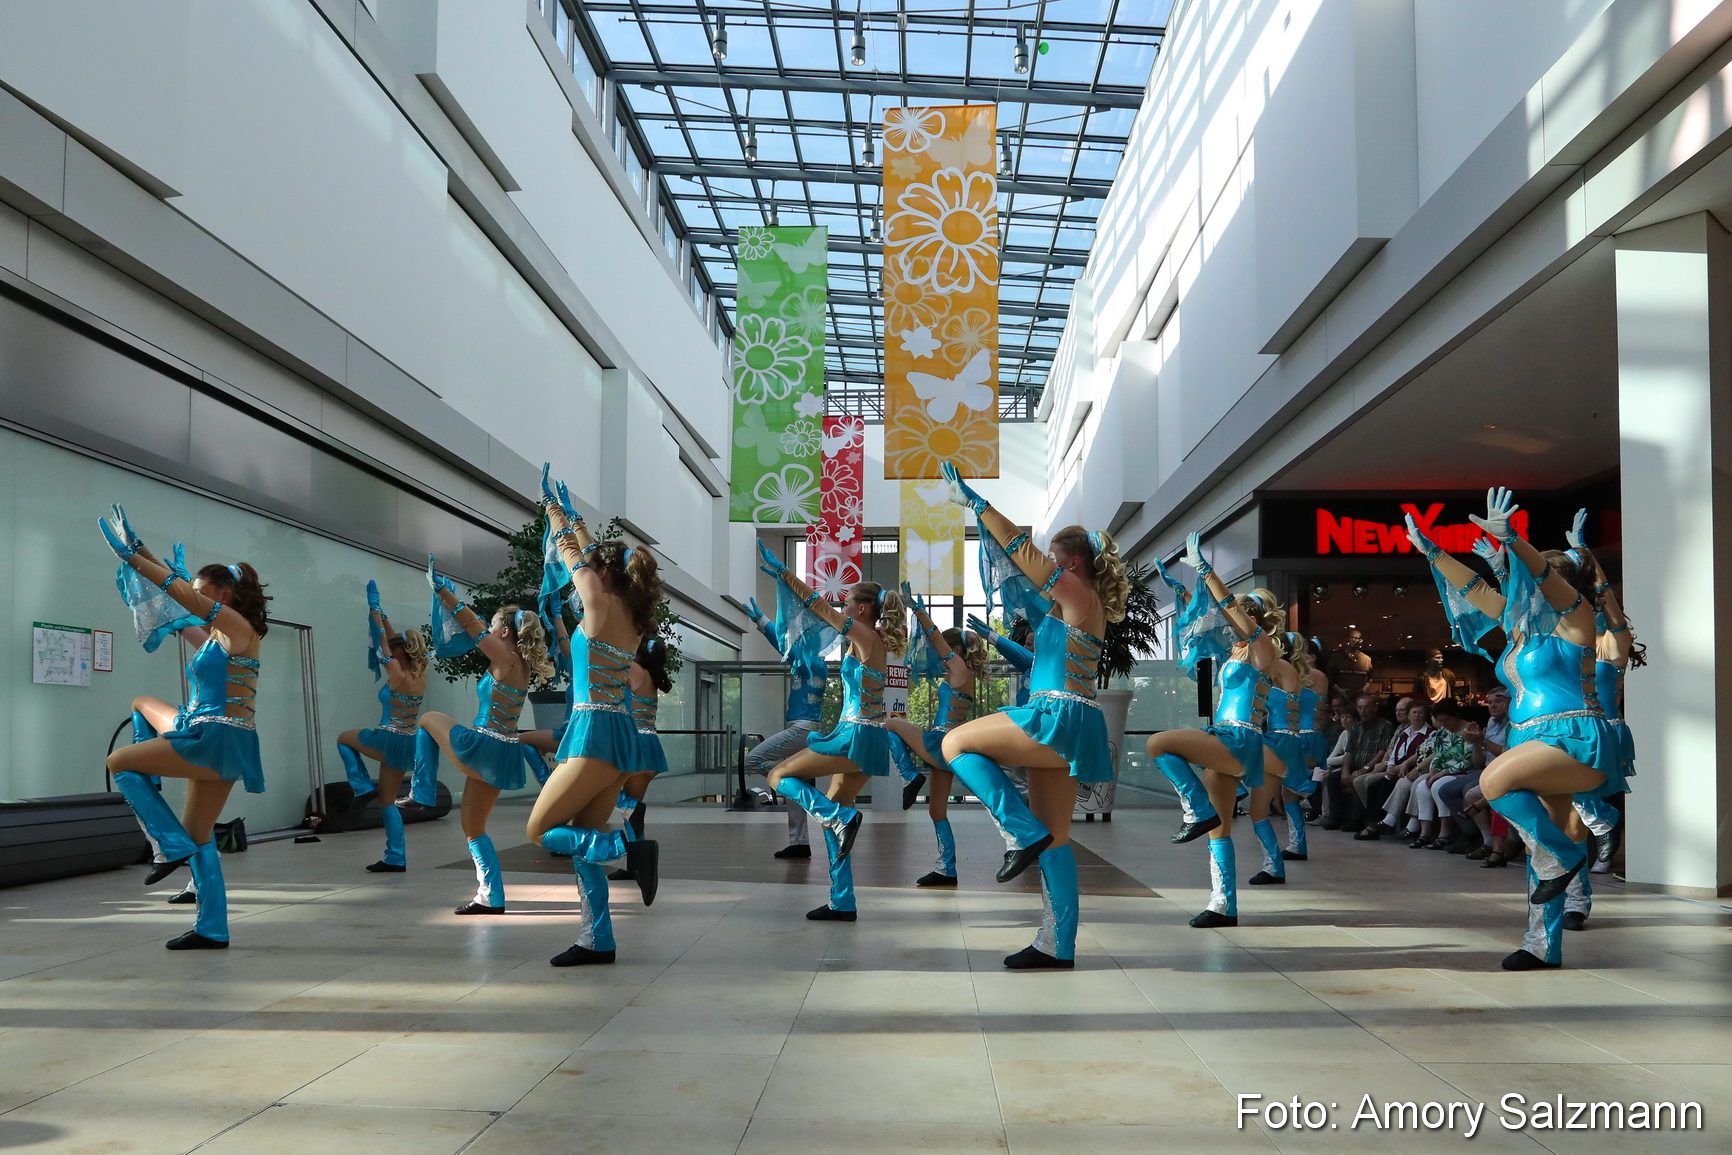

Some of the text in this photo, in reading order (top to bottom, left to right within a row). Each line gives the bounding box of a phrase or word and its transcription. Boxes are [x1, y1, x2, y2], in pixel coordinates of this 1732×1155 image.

[888, 666, 908, 678] REWE
[889, 678, 908, 687] CENTER
[892, 698, 905, 712] dm
